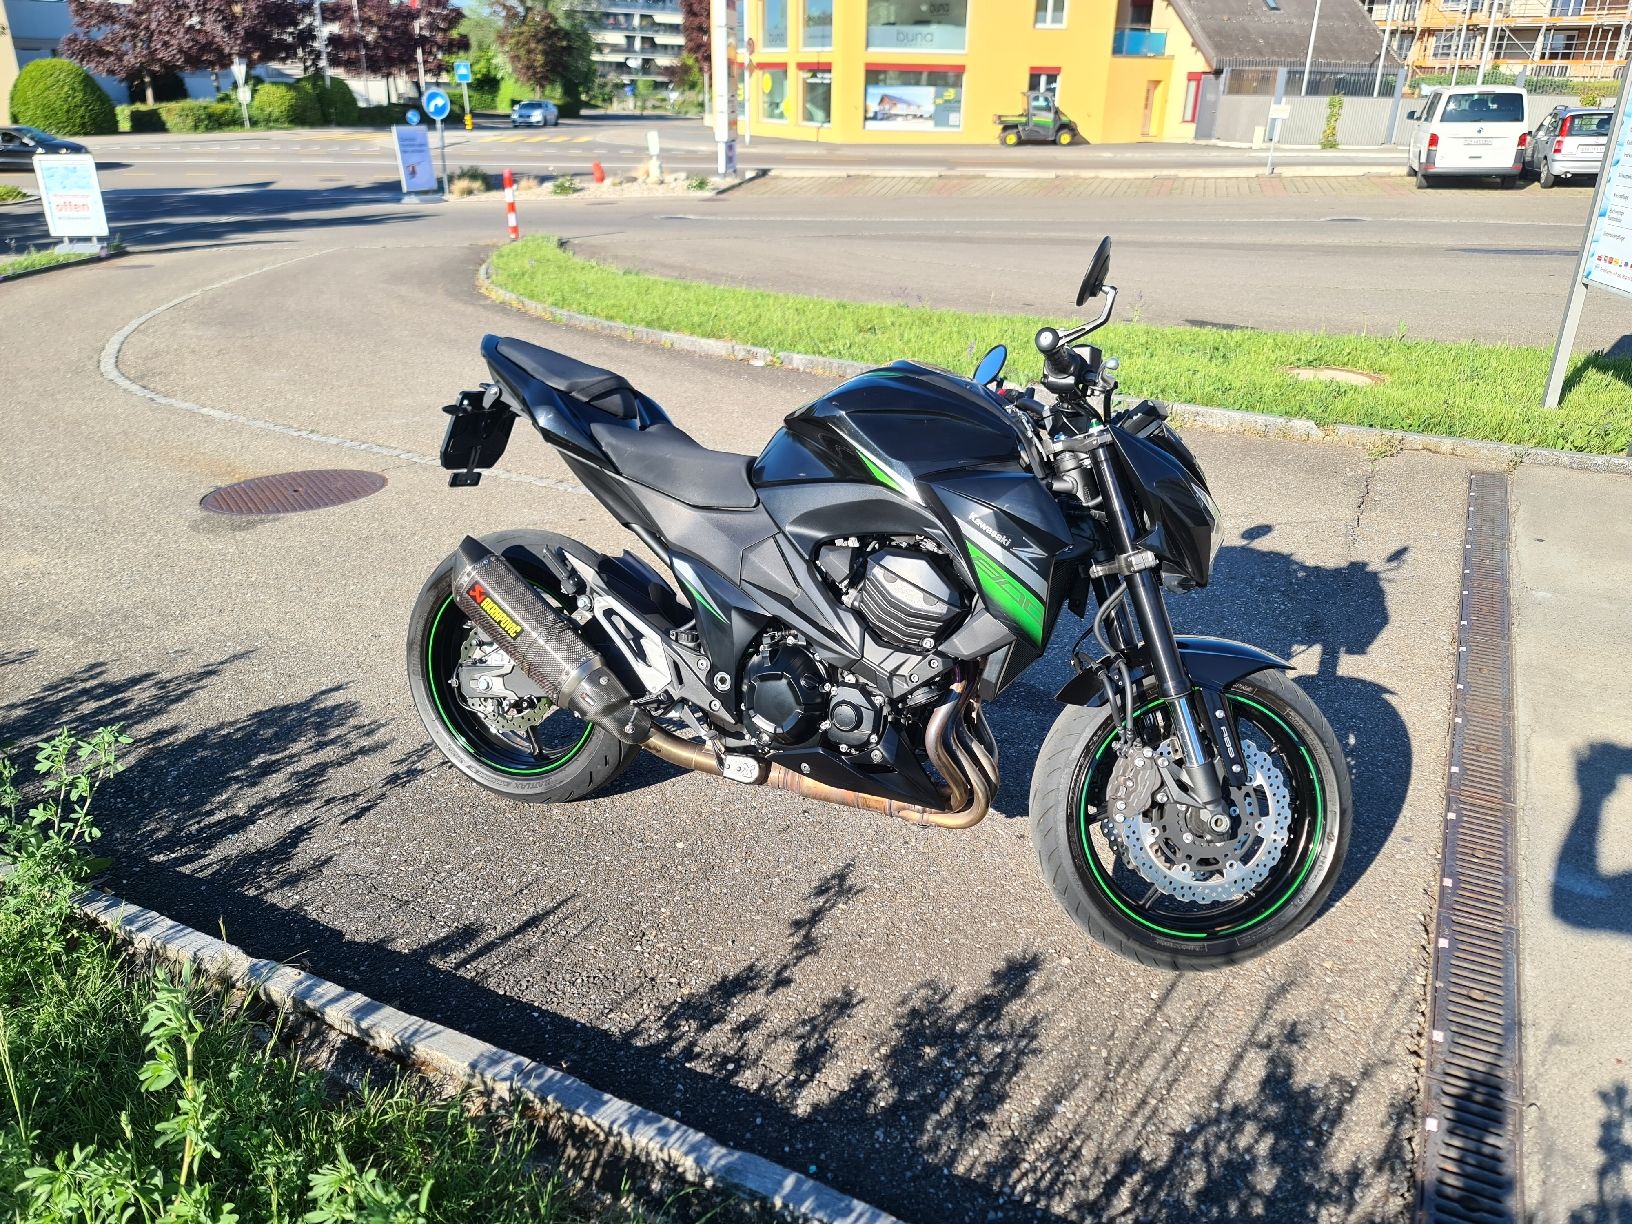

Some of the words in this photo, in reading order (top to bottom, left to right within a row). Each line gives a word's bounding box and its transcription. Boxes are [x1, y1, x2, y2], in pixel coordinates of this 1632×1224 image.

[55, 200, 90, 213] offen
[968, 511, 1012, 547] Kawasaki
[1010, 536, 1048, 570] Z
[1220, 726, 1235, 758] ABS
